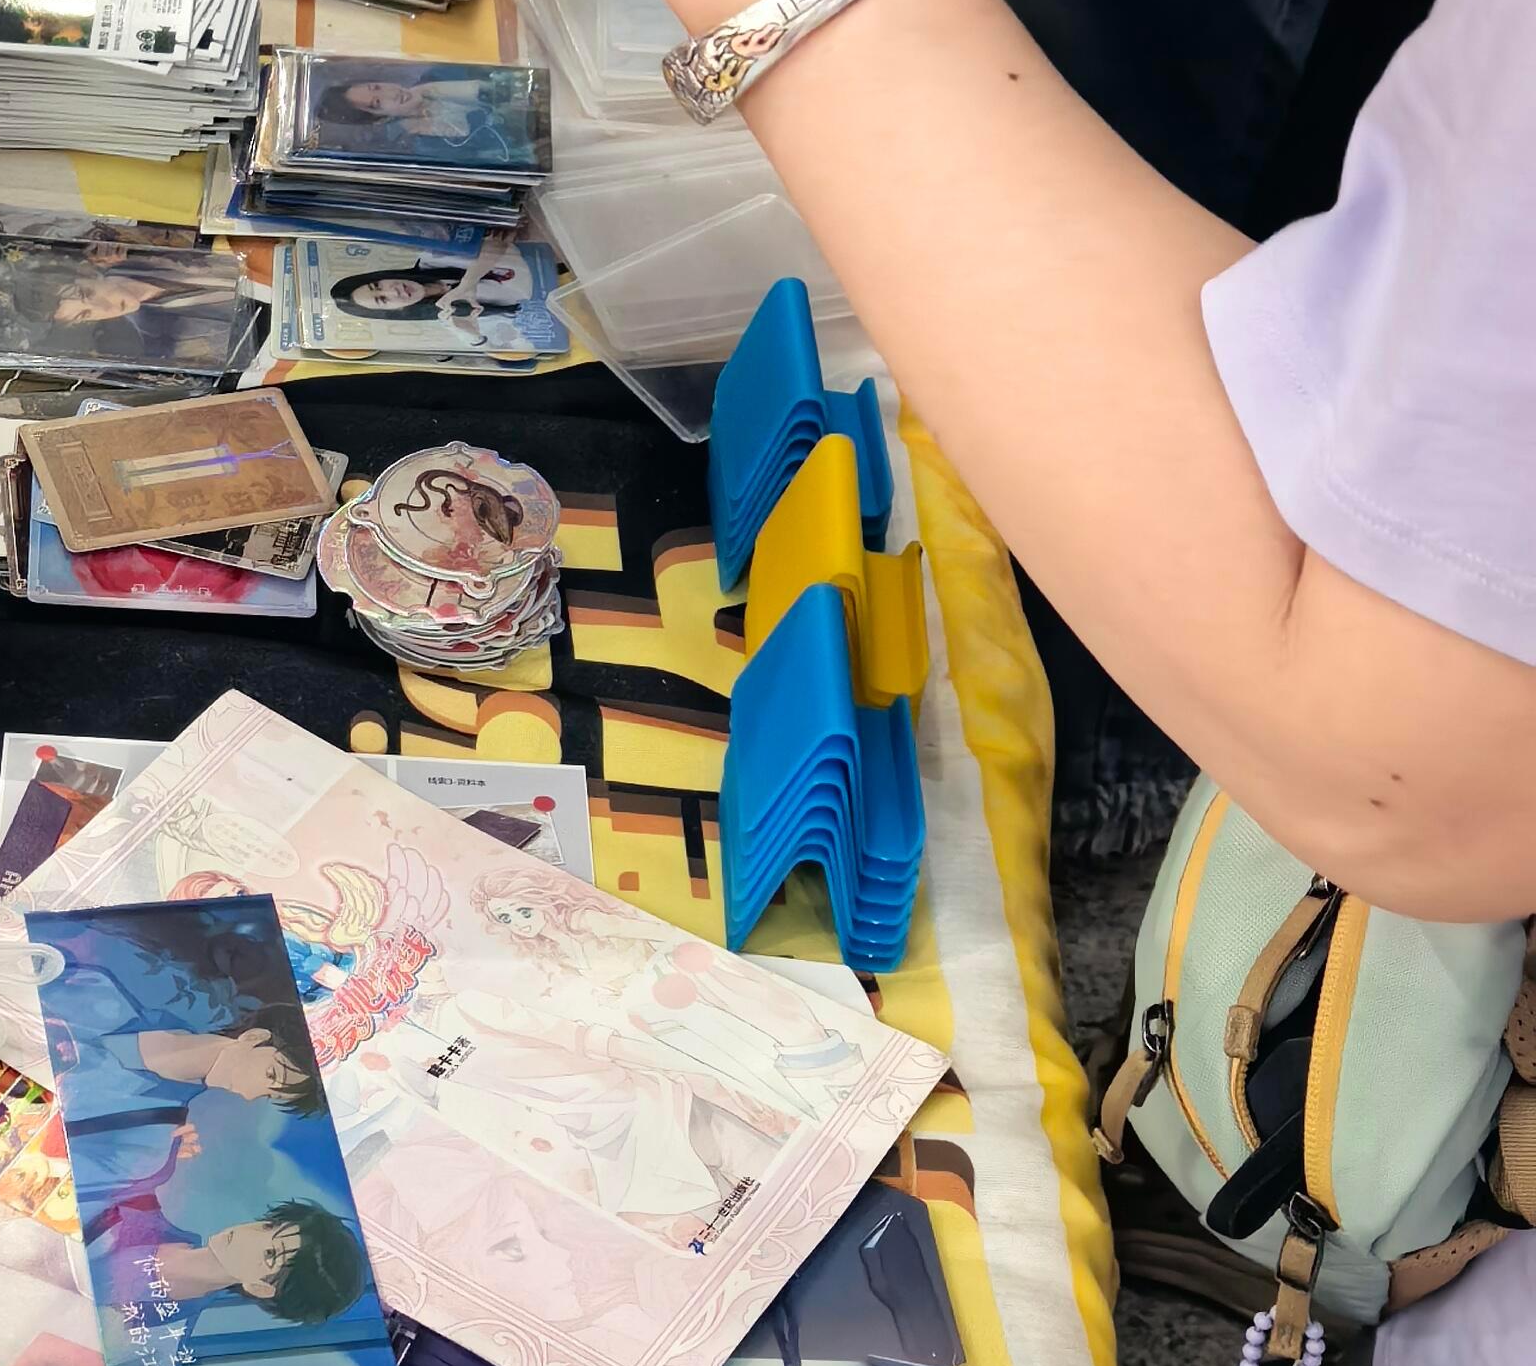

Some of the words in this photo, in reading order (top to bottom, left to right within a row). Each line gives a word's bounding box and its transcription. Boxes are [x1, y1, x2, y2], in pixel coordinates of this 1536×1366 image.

[697, 1175, 755, 1241] 二十一世纪出版社
